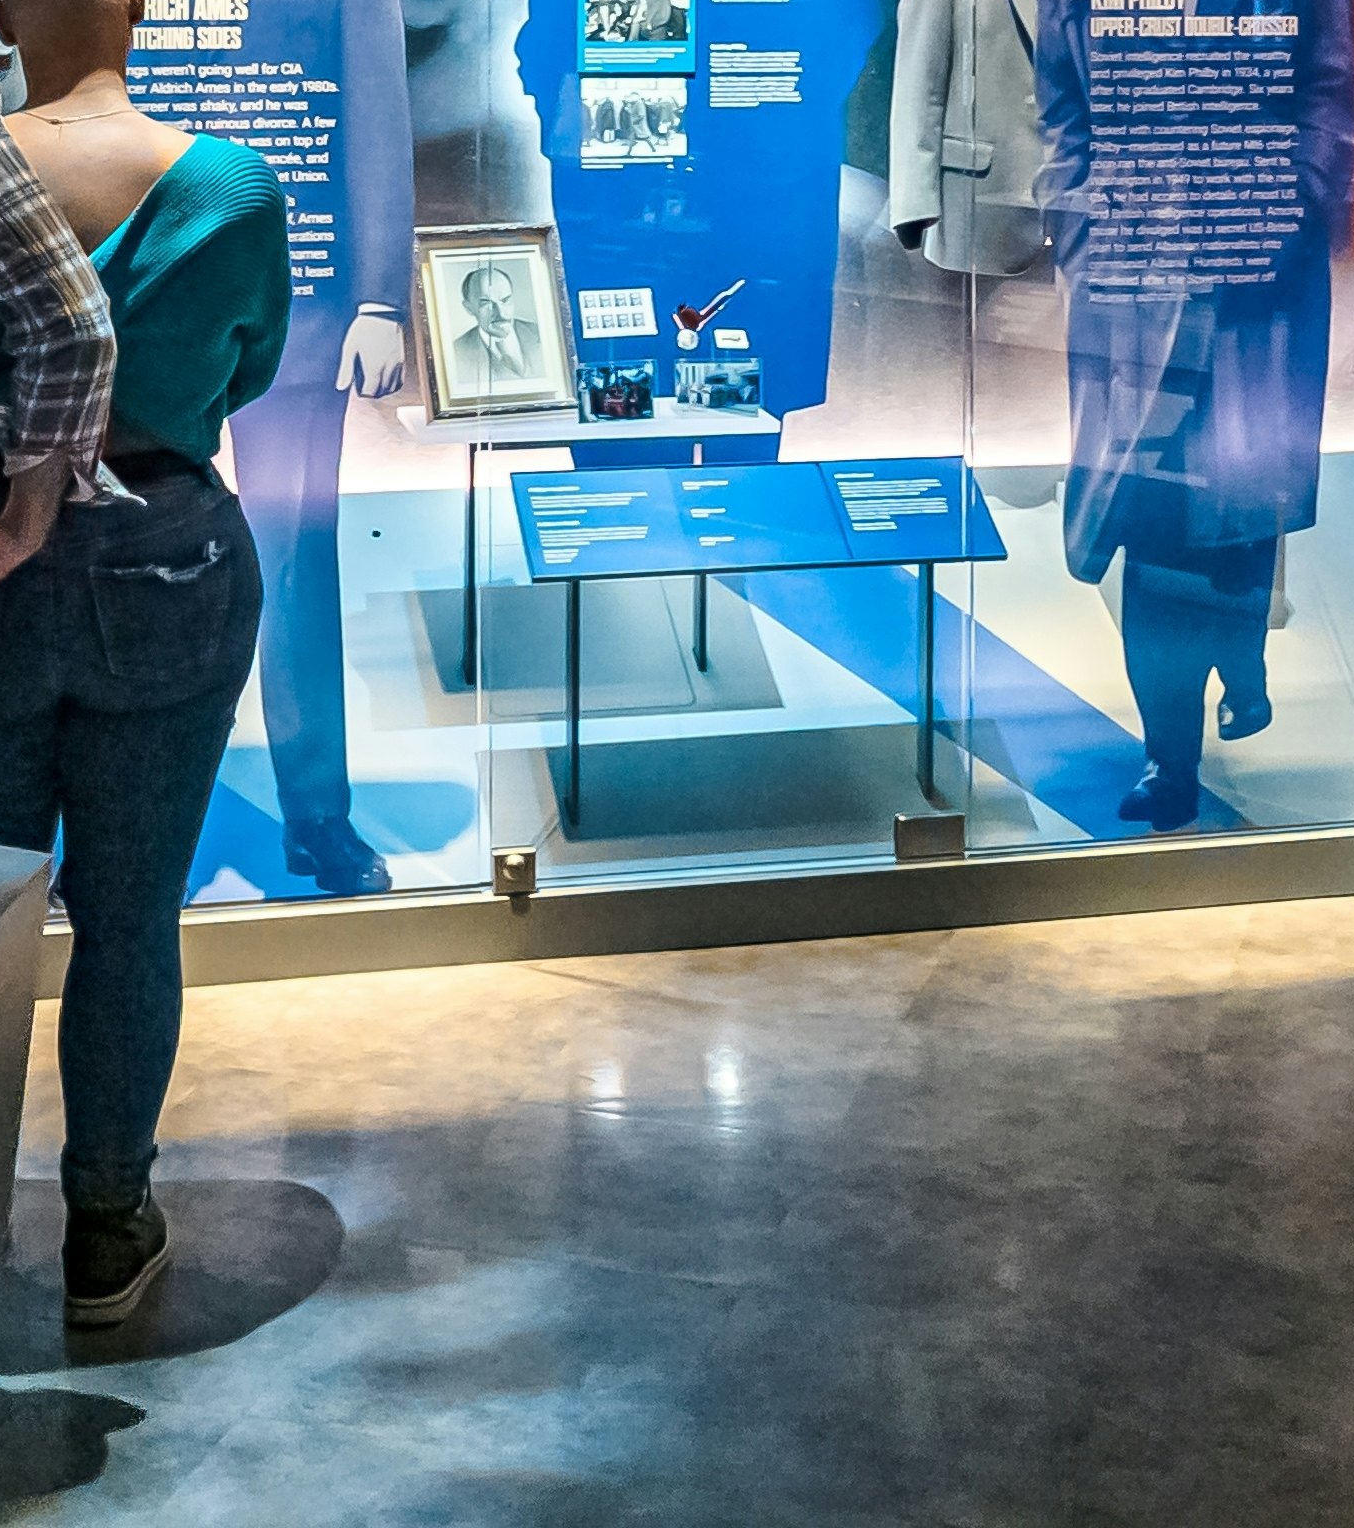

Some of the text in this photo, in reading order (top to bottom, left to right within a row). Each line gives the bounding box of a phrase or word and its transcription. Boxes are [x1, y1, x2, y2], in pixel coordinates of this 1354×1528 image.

[1091, 16, 1299, 36] UPPER-CRUST DOUBLE-CROSSER
[132, 27, 242, 49] ITCHING SIDES
[126, 63, 303, 79] ngs weren't going well for CIA
[150, 82, 193, 94] Aldrich
[195, 82, 231, 93] Ames
[234, 81, 245, 93] in
[247, 81, 267, 93] the
[269, 81, 298, 95] early
[302, 80, 340, 92] 1980s.
[172, 102, 197, 111] was
[240, 99, 263, 111] and
[265, 99, 281, 111] he
[284, 102, 308, 111] was
[301, 116, 314, 128] A
[314, 116, 336, 128] few
[246, 137, 272, 146] was
[274, 137, 291, 146] on
[293, 135, 313, 148] top
[315, 133, 329, 146] of
[306, 152, 329, 164] and
[292, 170, 330, 182] Union.
[297, 213, 333, 224] Ames
